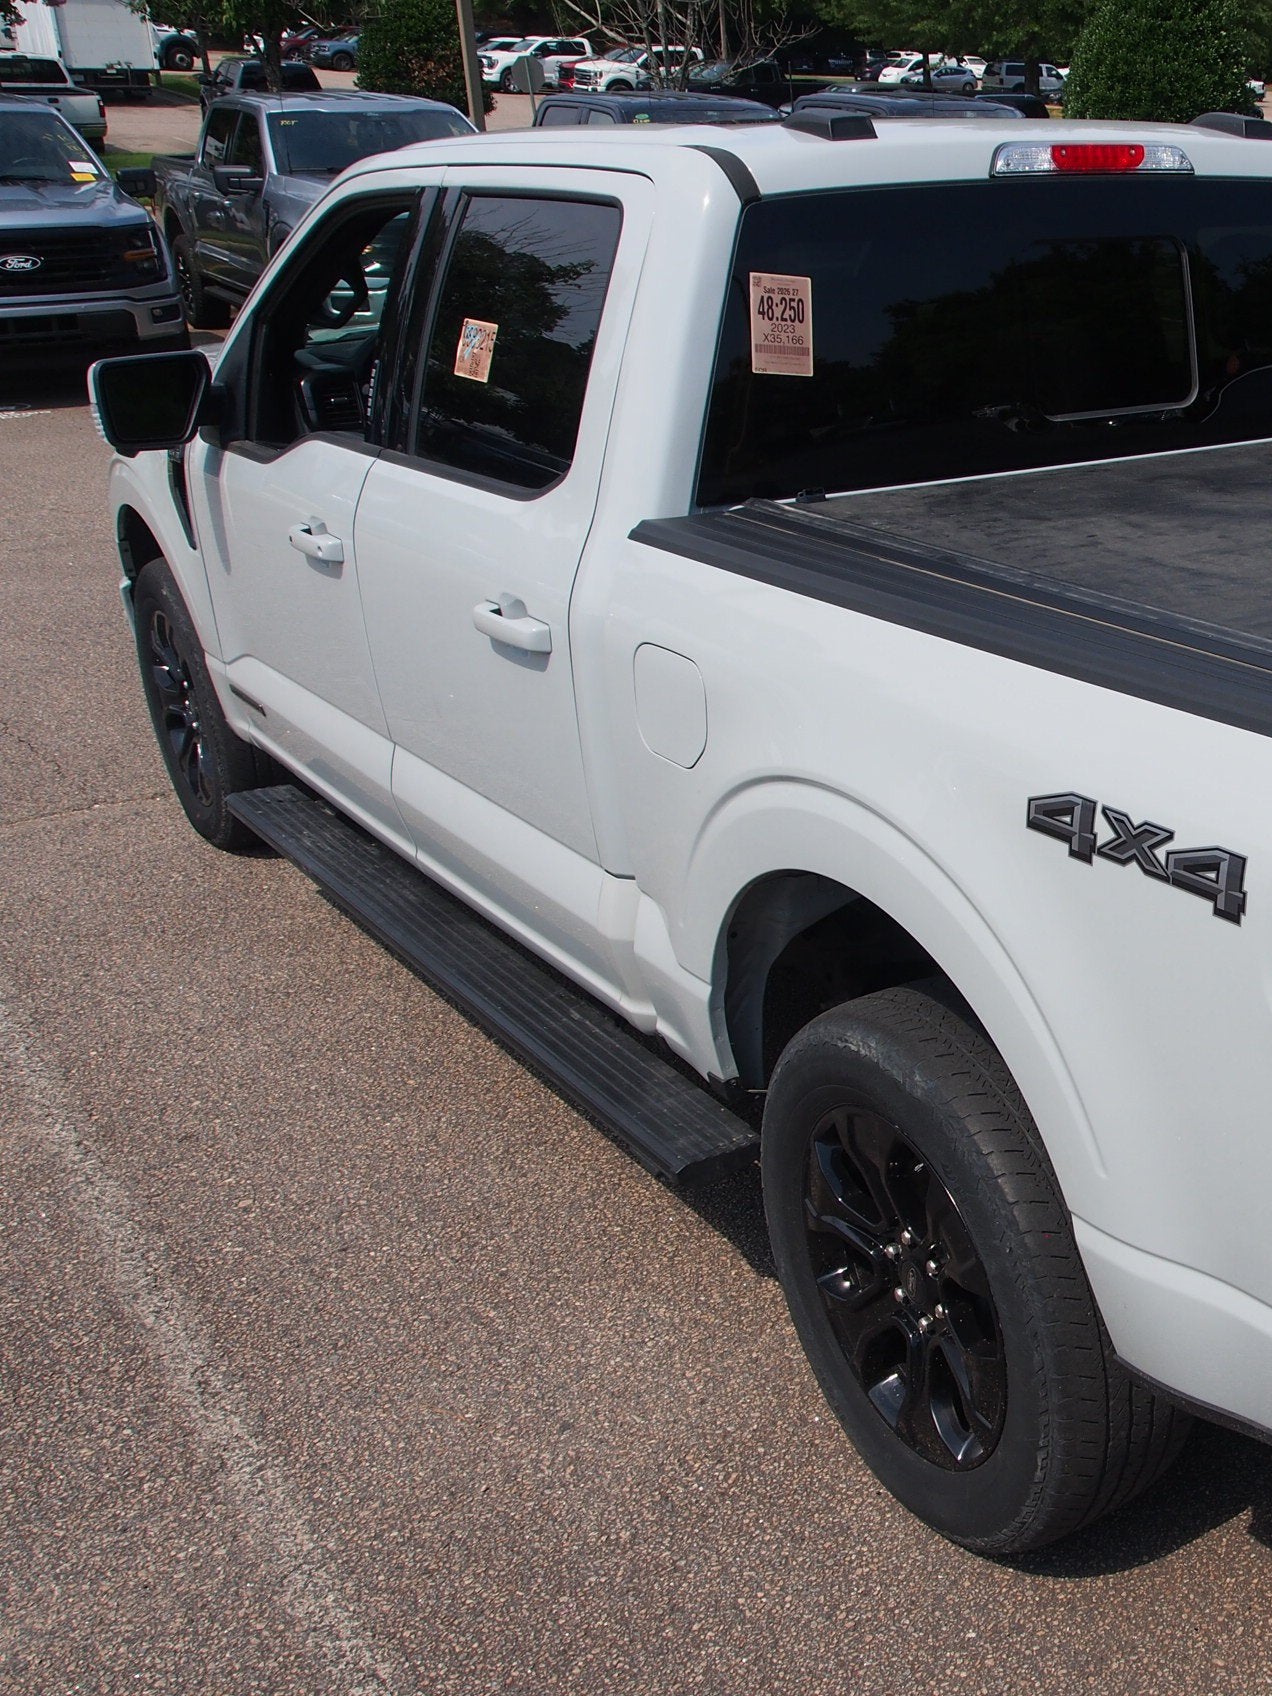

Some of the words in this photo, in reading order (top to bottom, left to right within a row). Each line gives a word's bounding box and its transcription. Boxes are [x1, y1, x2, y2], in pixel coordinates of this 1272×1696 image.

[6, 258, 32, 269] Ford
[763, 286, 775, 295] Sale
[792, 288, 799, 297] 27
[757, 295, 805, 324] 48:250
[770, 323, 796, 334] 2023
[762, 333, 804, 346] X35,166
